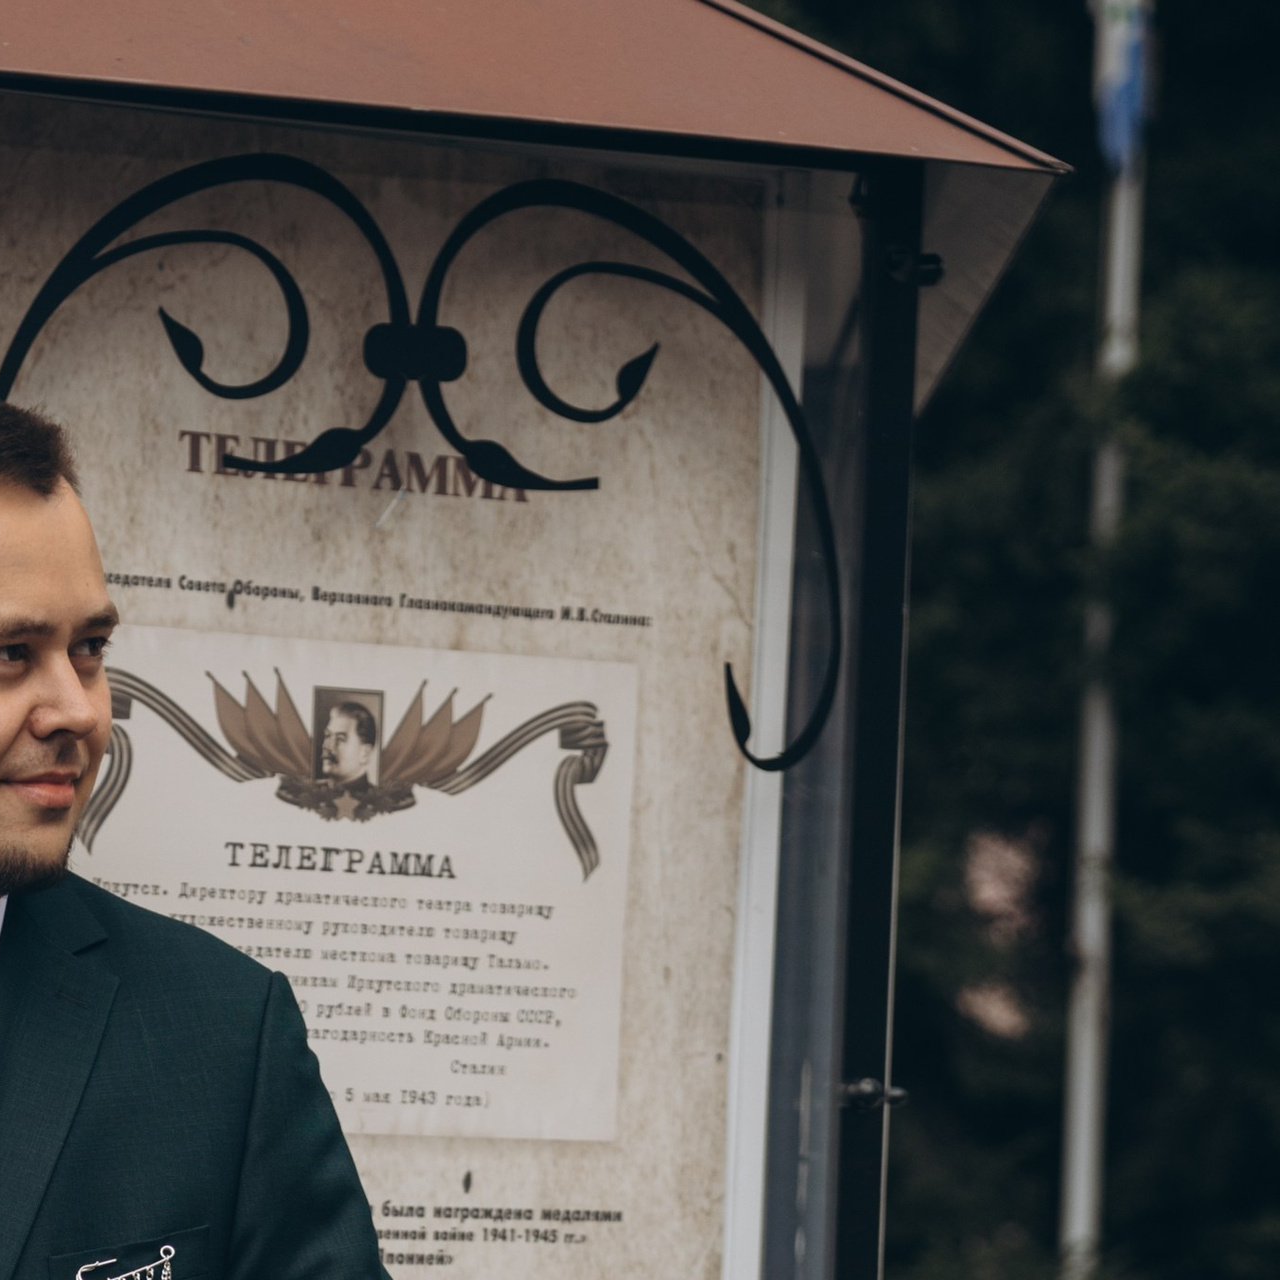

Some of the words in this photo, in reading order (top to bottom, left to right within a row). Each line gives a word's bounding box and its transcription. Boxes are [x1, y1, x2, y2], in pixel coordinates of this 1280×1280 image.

[179, 430, 529, 503] ТЕЛЕРАММ
[225, 842, 456, 879] ТЕЛЕГРАММА
[178, 882, 267, 904] Директору
[275, 890, 409, 910] драматического
[417, 899, 472, 915] театра
[481, 901, 555, 920] товарищу
[322, 920, 436, 938] руководителю
[444, 926, 518, 944] товарищу
[322, 948, 396, 964] месткома
[405, 952, 479, 970] товарищу
[347, 975, 440, 995] Иркутского
[449, 981, 577, 998] драматического
[317, 1002, 371, 1019] рублей
[382, 1006, 391, 1018] в
[399, 1004, 436, 1022] Фонд
[445, 1006, 509, 1024] Обороны
[516, 1009, 562, 1028] СССР,
[423, 1028, 488, 1047] Красной
[497, 1033, 550, 1049] Армии.
[451, 1060, 507, 1076] Сталин
[345, 1088, 354, 1102] 5
[363, 1091, 392, 1104] мая
[381, 1201, 425, 1219] была
[433, 1205, 533, 1224] награждена
[541, 1208, 623, 1224] медалями
[434, 1227, 474, 1241] войне
[482, 1227, 558, 1244] 1941-1945
